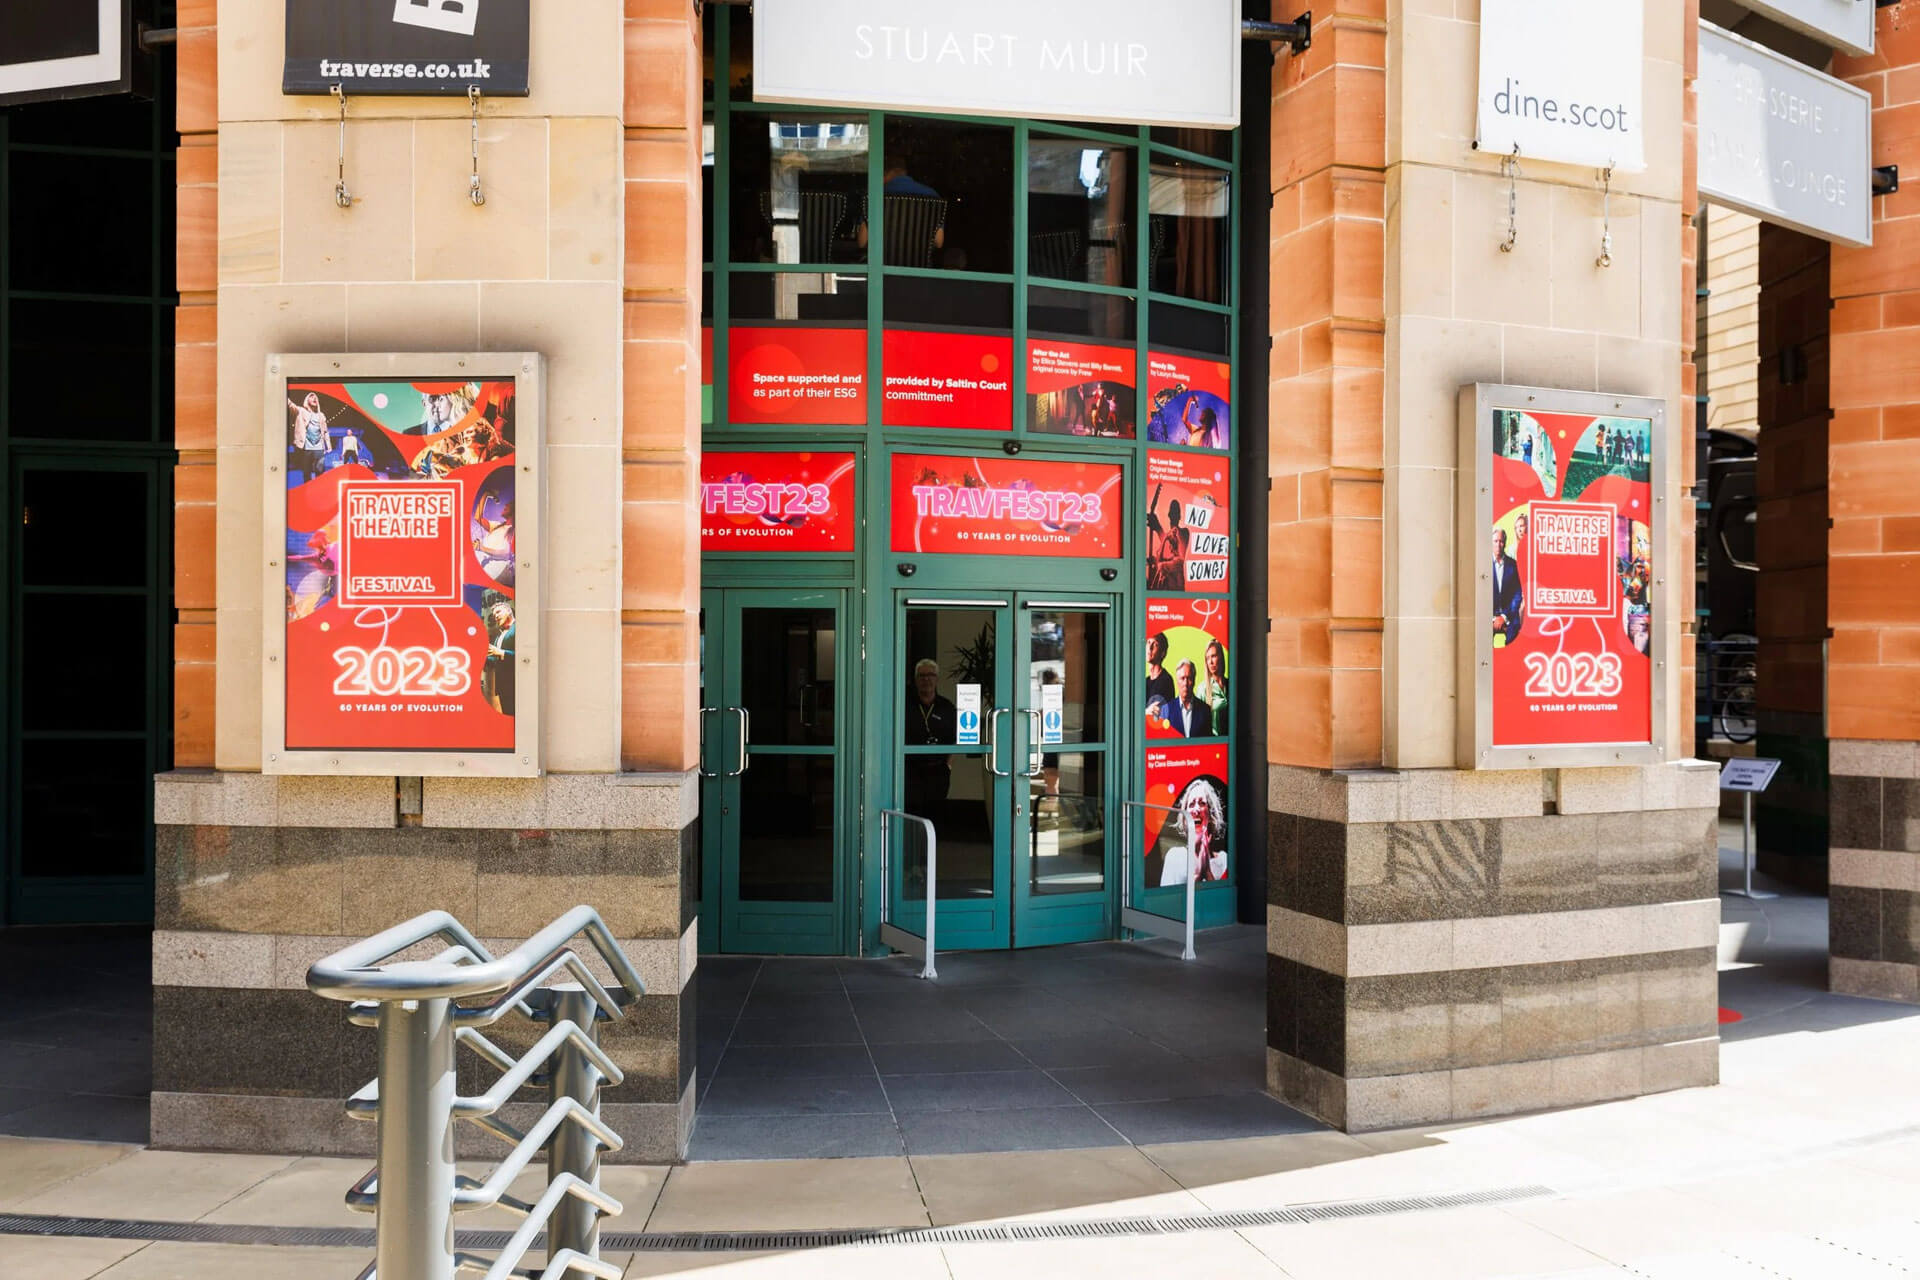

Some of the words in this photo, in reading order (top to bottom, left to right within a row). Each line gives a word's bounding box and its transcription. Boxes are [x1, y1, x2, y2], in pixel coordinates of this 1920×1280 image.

[855, 24, 1018, 68] STUART
[1039, 39, 1148, 77] MUIR
[320, 59, 490, 79] traverse.co.uk
[1494, 77, 1628, 132] dine.scot
[753, 373, 785, 384] Space
[788, 374, 839, 385] supported
[842, 374, 862, 384] and
[886, 376, 929, 387] provided
[932, 378, 944, 389] by
[946, 378, 978, 389] Saltire
[980, 380, 1007, 391] Court
[753, 389, 766, 397] as
[769, 388, 790, 399] part
[793, 387, 804, 397] of
[806, 387, 831, 398] their
[834, 387, 857, 398] ESG
[886, 391, 953, 403] committment
[351, 494, 451, 517] TRAVERSE
[912, 485, 1102, 523] TRAVFEST23
[1188, 506, 1206, 527] NO
[1536, 512, 1609, 536] TRAVERSE
[351, 516, 439, 539] THEATRE
[718, 528, 732, 536] OF
[736, 528, 794, 537] EVOLUTION
[957, 532, 969, 540] 60
[972, 532, 1001, 541] YEARS
[1004, 533, 1017, 542] OF
[1020, 534, 1071, 543] EVOLUTION
[1194, 534, 1226, 554] LOVE
[1537, 534, 1600, 556] THEATRE
[1190, 561, 1224, 580] SONGS
[351, 576, 435, 592] FESTIVAL
[1536, 588, 1597, 605] FESTIVAL
[333, 645, 472, 697] 2023
[1524, 652, 1623, 698] 2023
[340, 704, 353, 712] 60
[355, 704, 387, 712] YEARS
[390, 704, 403, 712] OF
[407, 704, 464, 712] EVOLUTION
[1542, 704, 1565, 712] YEARS
[1578, 704, 1618, 712] EVOLUTION
